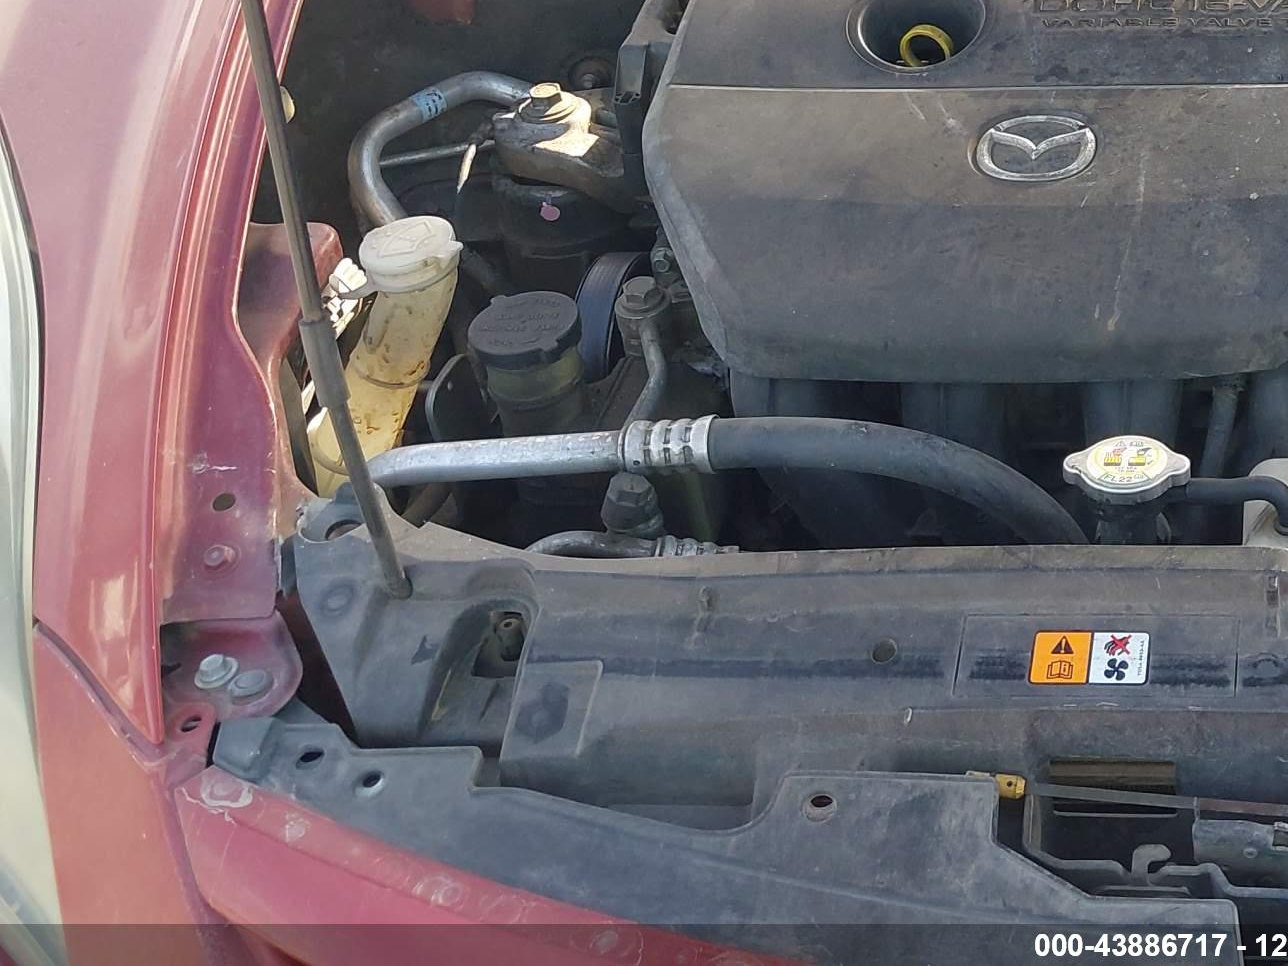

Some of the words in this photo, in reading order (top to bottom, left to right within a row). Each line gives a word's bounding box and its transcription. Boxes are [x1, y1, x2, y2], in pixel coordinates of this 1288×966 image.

[1042, 18, 1180, 27] VARIABLE
[1187, 18, 1272, 27] VALVE
[1103, 474, 1133, 483] FL22
